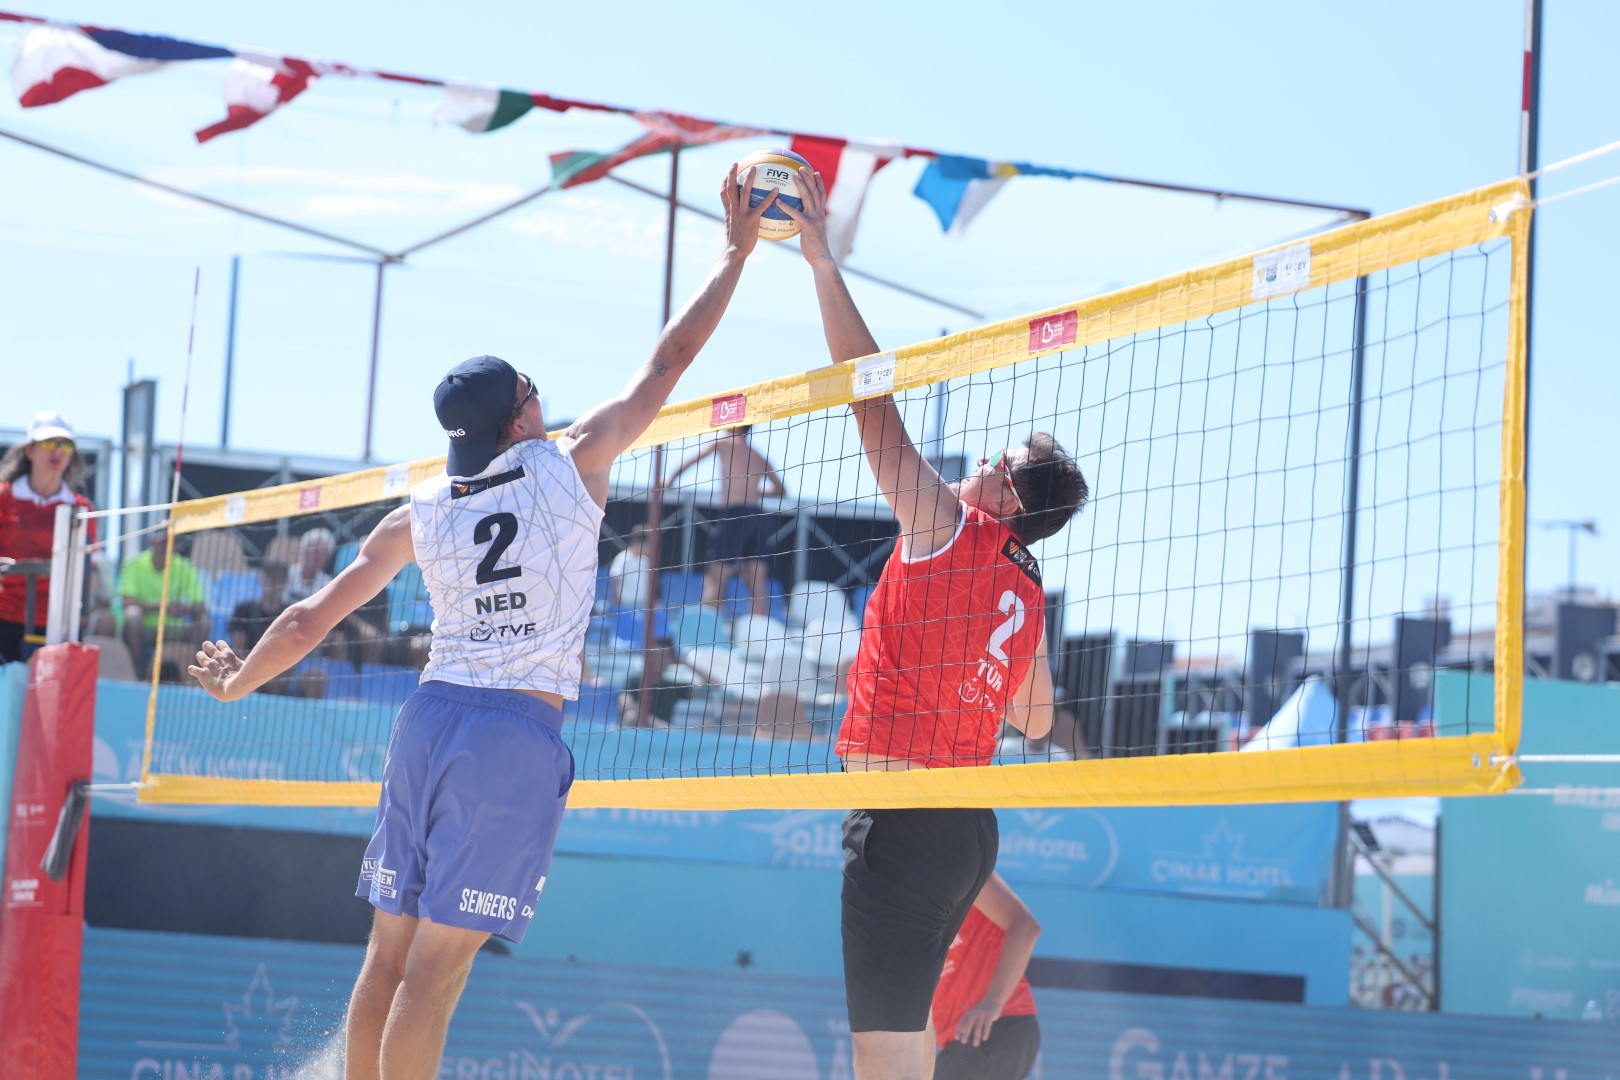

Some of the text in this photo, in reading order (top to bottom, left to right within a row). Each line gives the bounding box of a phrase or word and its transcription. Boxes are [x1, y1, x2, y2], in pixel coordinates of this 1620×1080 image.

[473, 512, 522, 586] 2
[474, 591, 527, 615] NED
[498, 622, 537, 638] TVF
[985, 589, 1025, 669] 2
[459, 888, 517, 920] SENGERS
